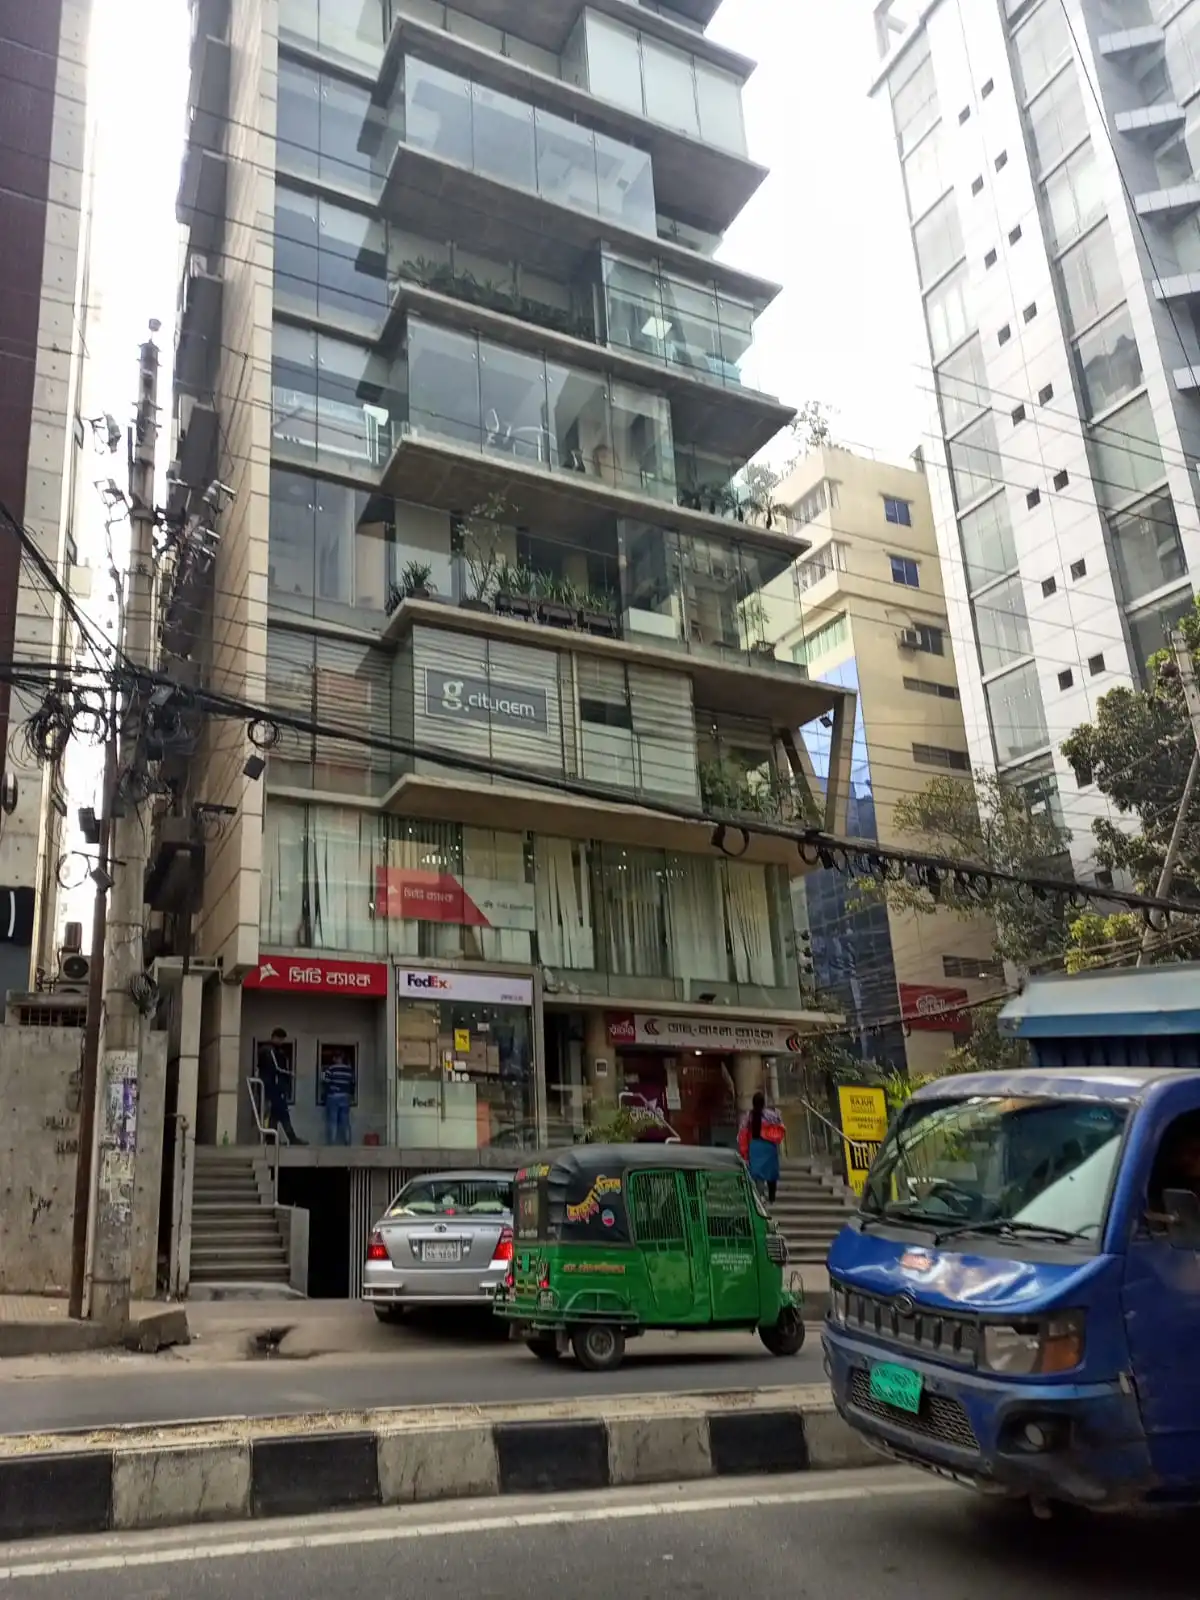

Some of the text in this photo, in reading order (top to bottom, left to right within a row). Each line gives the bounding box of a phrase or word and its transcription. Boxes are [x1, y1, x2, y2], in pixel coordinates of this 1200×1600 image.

[288, 966, 371, 988] সিটি ব্যাংক
[407, 973, 448, 989] FedEx
